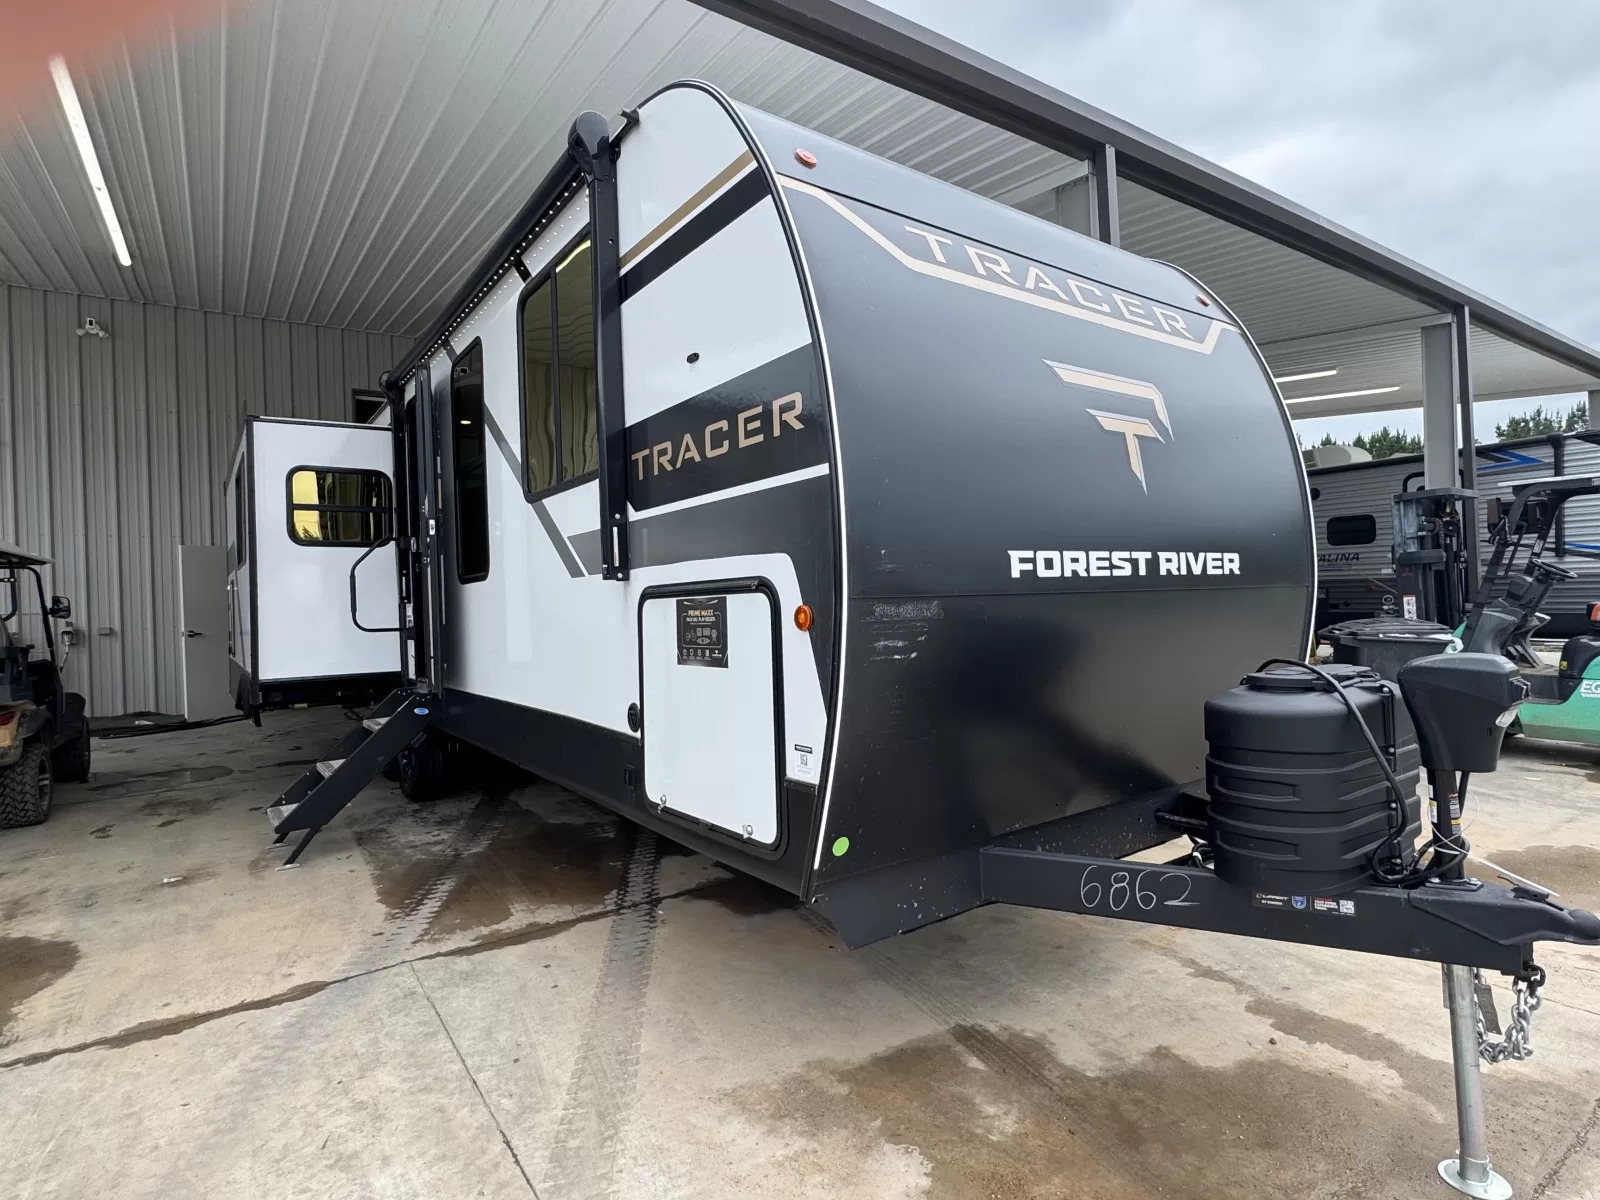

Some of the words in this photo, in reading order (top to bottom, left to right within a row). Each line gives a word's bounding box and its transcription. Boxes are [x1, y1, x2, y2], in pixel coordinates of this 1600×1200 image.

[904, 225, 1194, 340] TRACER
[631, 391, 805, 481] TRACER
[1007, 550, 1152, 578] FOREST
[1157, 551, 1241, 576] RIVER
[1317, 552, 1360, 562] ALINA
[1080, 865, 1201, 911] 6862
